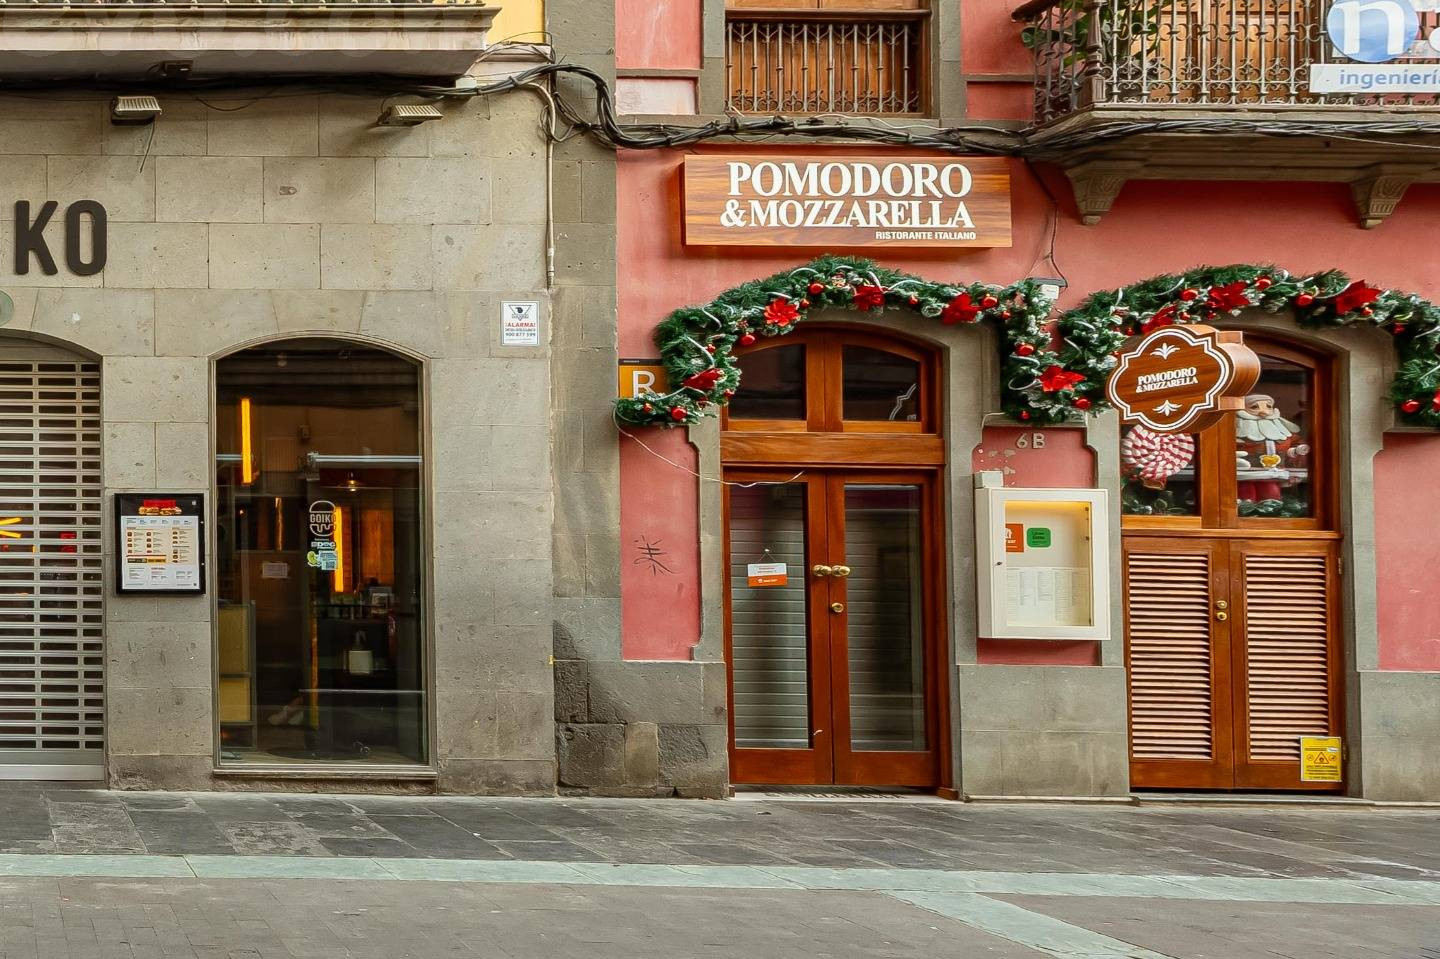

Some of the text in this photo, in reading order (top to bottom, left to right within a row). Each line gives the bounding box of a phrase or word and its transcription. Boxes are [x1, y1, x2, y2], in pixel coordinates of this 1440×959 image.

[1340, 69, 1440, 90] ingenierí
[726, 161, 972, 199] POMODORO
[875, 231, 976, 241] RISTORANTE ITALIANO
[632, 370, 659, 400] R
[1137, 366, 1197, 385] POMODORO
